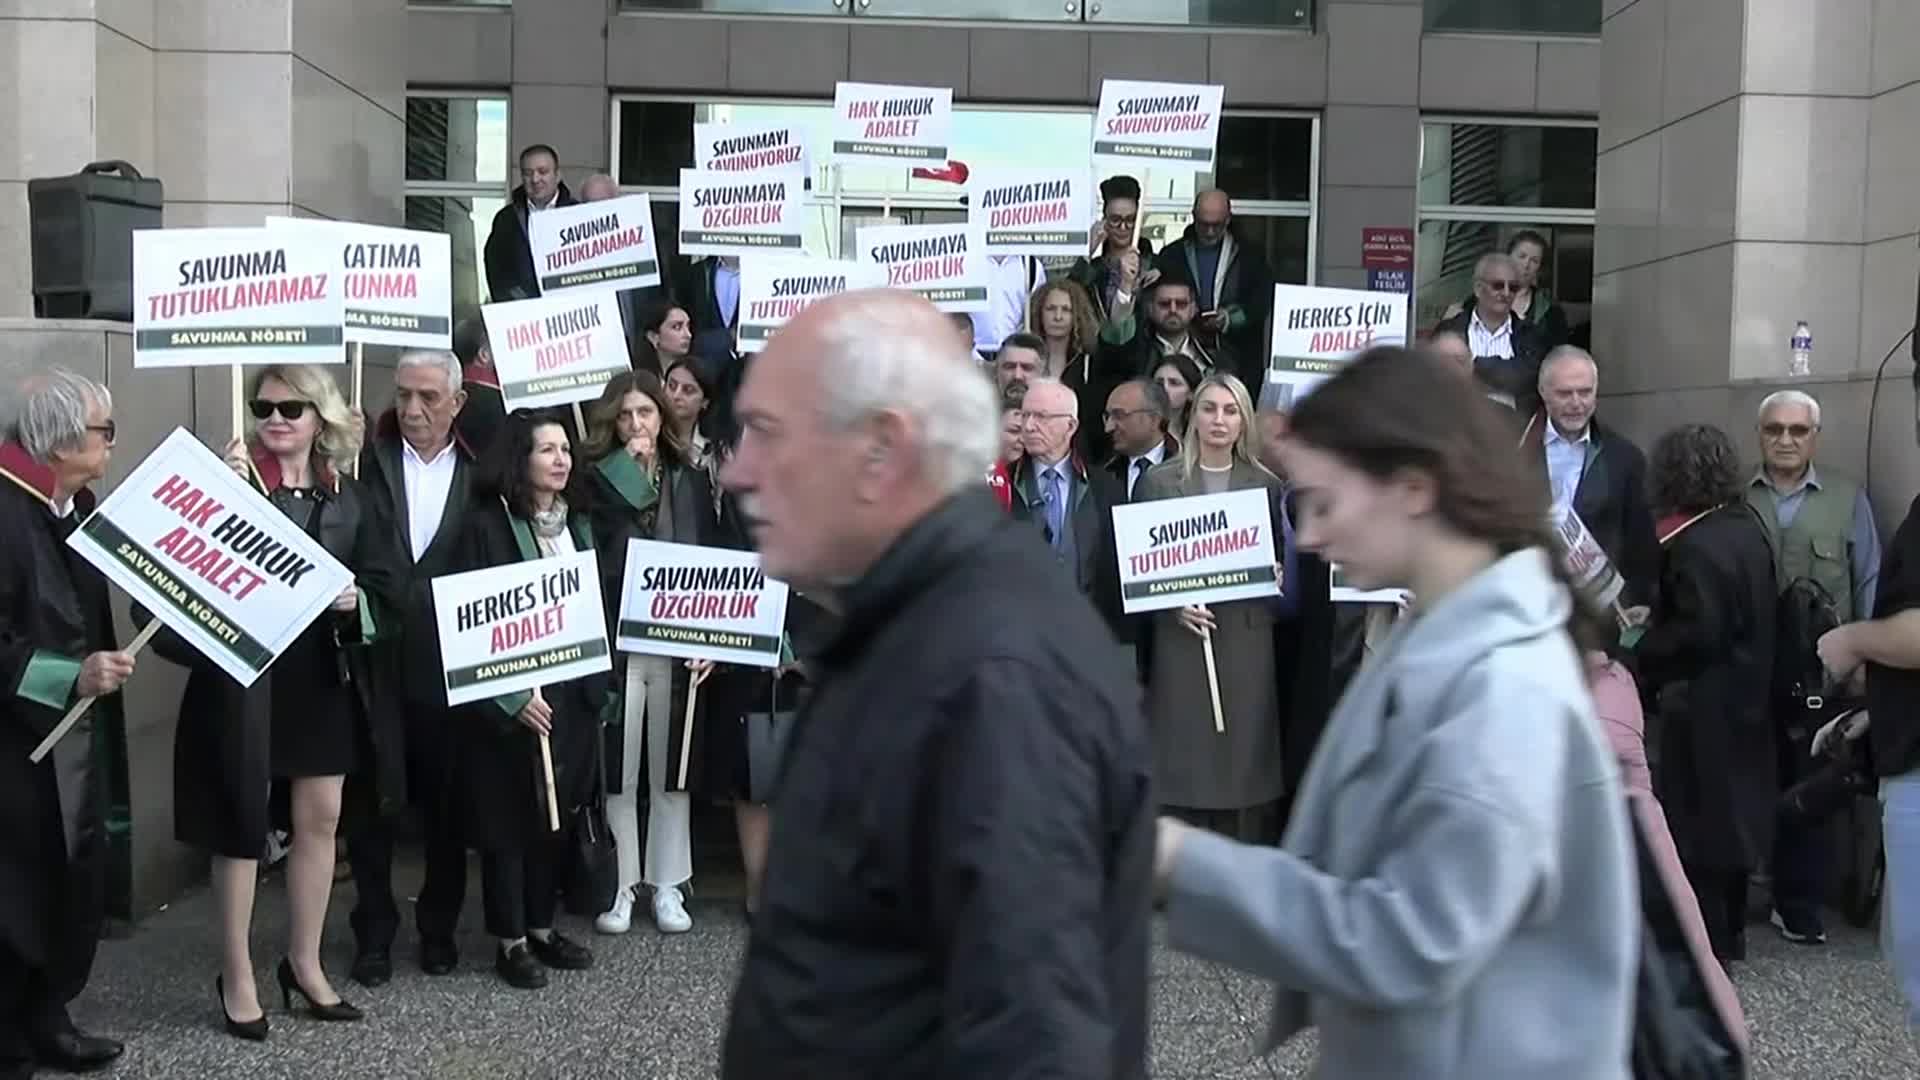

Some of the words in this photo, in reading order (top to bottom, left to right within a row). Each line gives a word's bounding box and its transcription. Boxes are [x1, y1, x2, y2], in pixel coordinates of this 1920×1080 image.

[848, 101, 879, 119] HAK
[882, 97, 934, 117] HUKUK
[1116, 94, 1200, 116] SAVUNMAYI
[864, 119, 919, 138] ADALET
[1106, 113, 1210, 135] SAVUNUYORUZ
[713, 129, 788, 157] SAVUNMAYI
[694, 182, 785, 207] SAVUNMAYA
[982, 179, 1070, 208] AVUKATIMA
[703, 204, 782, 228] ÖZGÜRLÜK
[990, 201, 1067, 228] DOKUNMA
[559, 213, 620, 248] SAVUNMA
[545, 225, 645, 271] TUTUKLANAMAZ
[871, 233, 967, 263] SAVUNMAYA
[178, 249, 287, 287] SAVUNMA
[148, 273, 328, 320] TUTUKLANAMAZ
[771, 275, 846, 297] SAVUNMA
[507, 320, 543, 351] HAK
[545, 303, 602, 340] HUKUK
[1288, 306, 1352, 330] HERKES
[1357, 301, 1392, 330] İÇİN
[170, 331, 247, 345] SAVUNMA
[1309, 329, 1375, 353] ADALET
[536, 333, 594, 373] ADALET
[151, 474, 225, 529] HAK
[211, 513, 315, 589] HUKUK
[1149, 510, 1228, 548] SAVUNMA
[154, 526, 267, 602] ADALET
[1129, 526, 1260, 577] TUTUKLANAMAZ
[117, 542, 188, 606] SAVUNMA
[188, 600, 241, 645] NÖBETİ
[641, 566, 765, 592] SAVUNMAYA
[1150, 578, 1205, 593] SAVUNMA
[457, 582, 536, 632] HERKES
[540, 567, 580, 605] İÇİN
[651, 591, 759, 620] ÖZGÜRLÜK
[490, 604, 566, 655] ADALET
[648, 627, 706, 643] SAVUNMA
[476, 657, 538, 680] SAVUNMA
